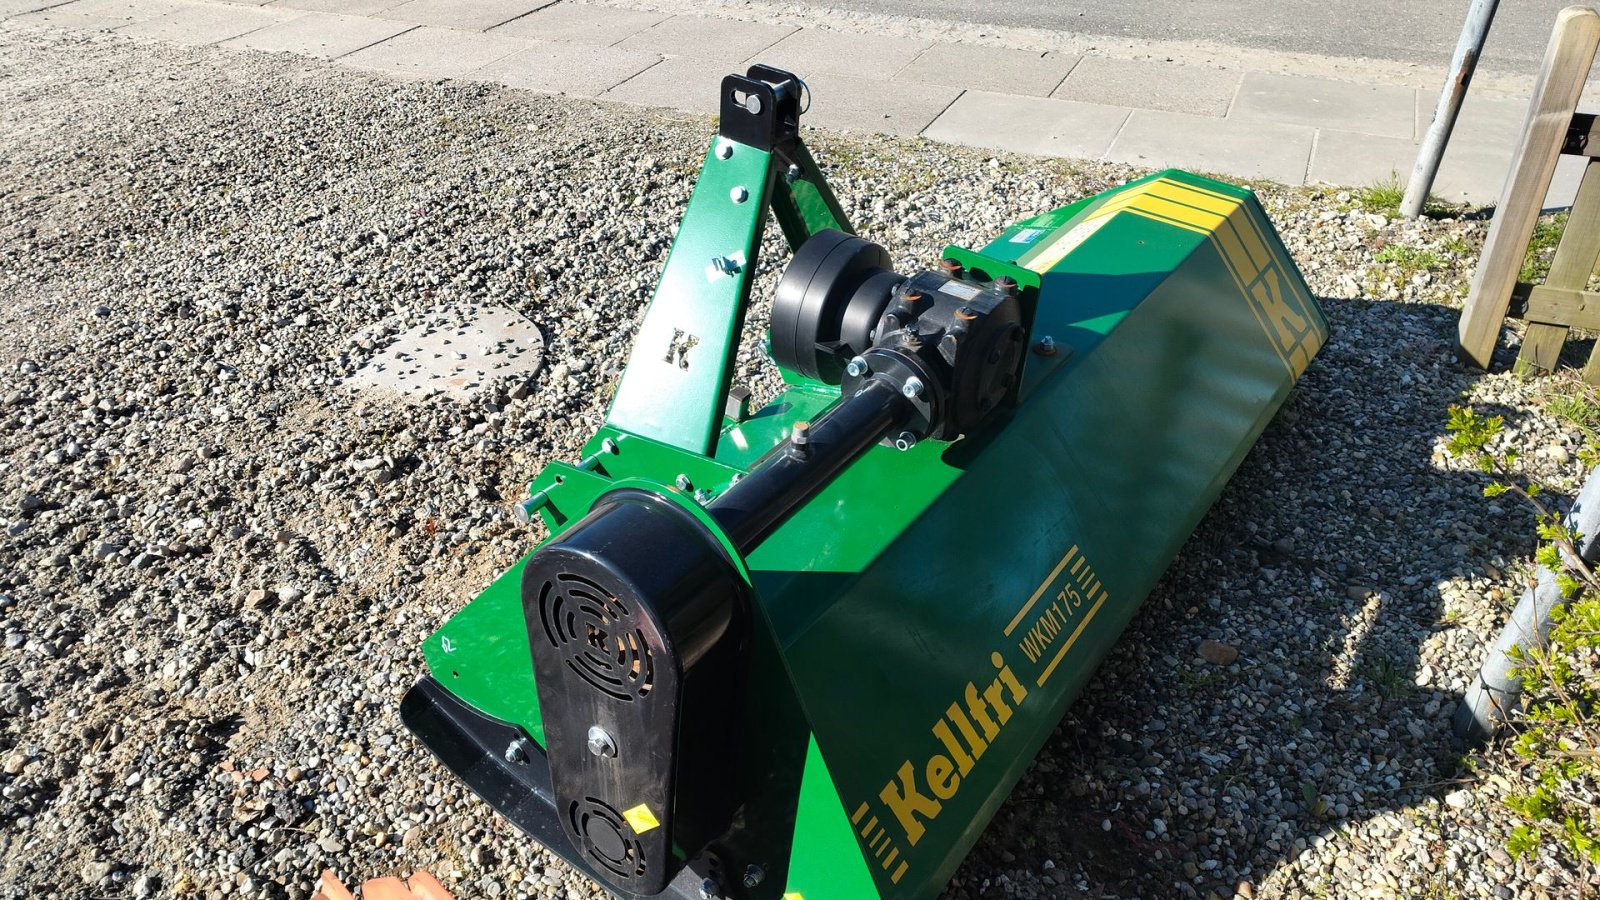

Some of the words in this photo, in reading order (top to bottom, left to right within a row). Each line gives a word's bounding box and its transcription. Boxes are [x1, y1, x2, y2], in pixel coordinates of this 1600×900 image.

[663, 327, 700, 372] K
[1251, 267, 1307, 352] K
[1018, 582, 1082, 664] WKM175
[879, 651, 1029, 847] Kellfri
